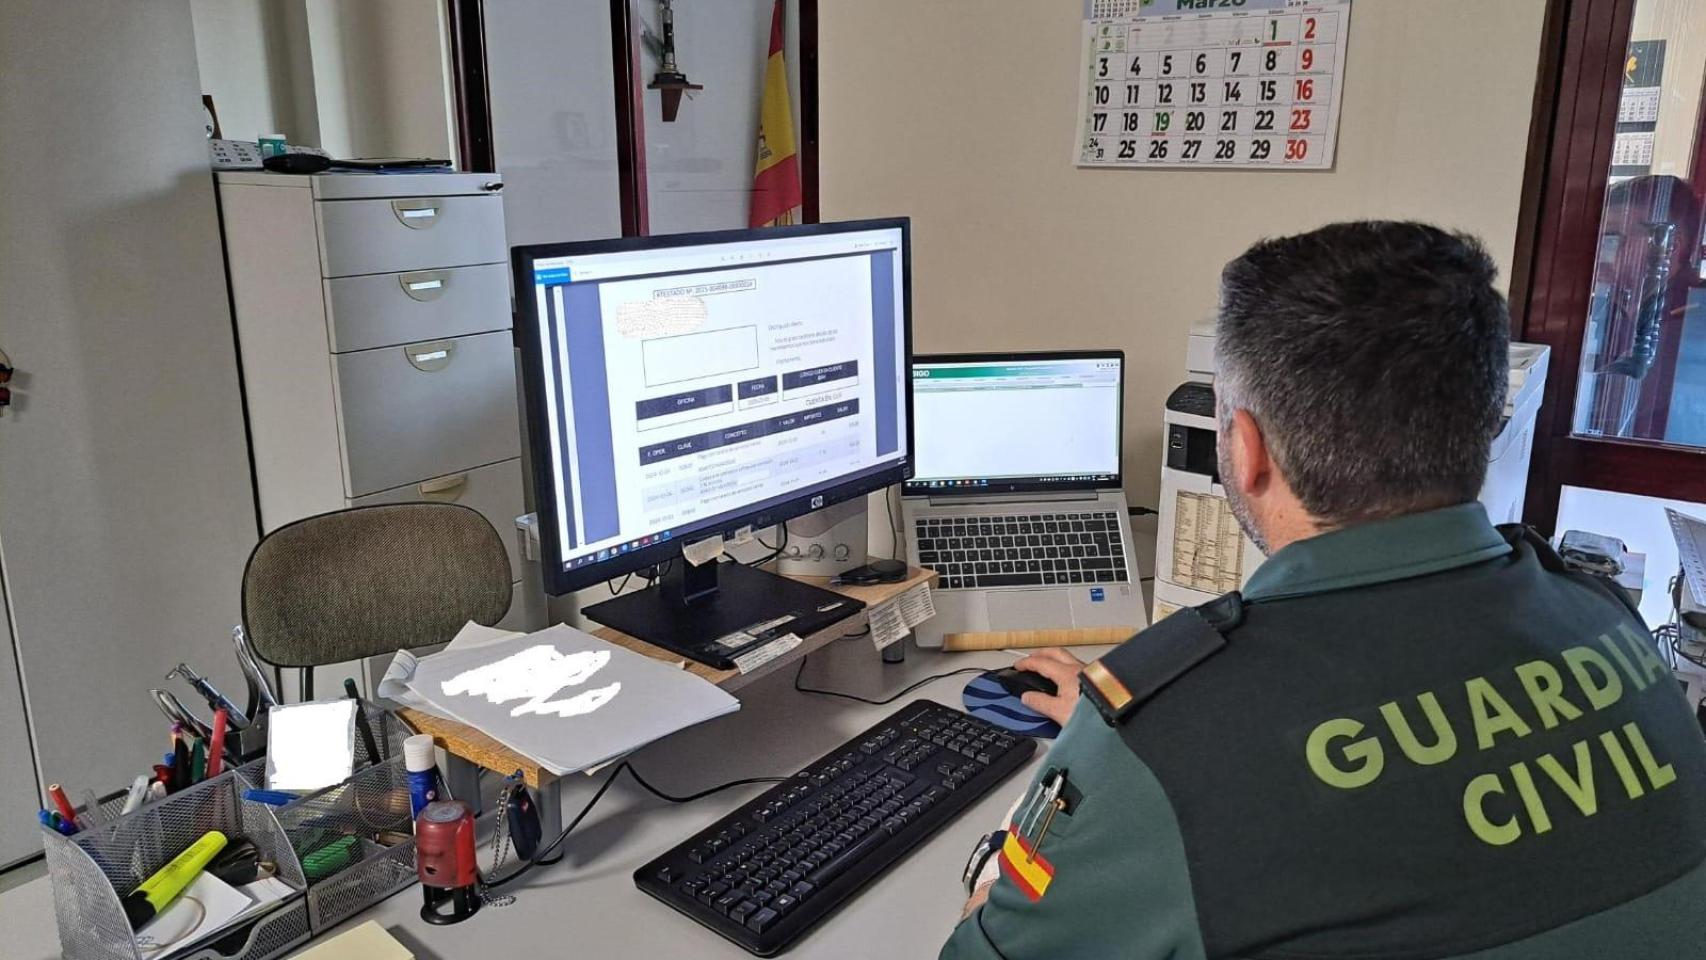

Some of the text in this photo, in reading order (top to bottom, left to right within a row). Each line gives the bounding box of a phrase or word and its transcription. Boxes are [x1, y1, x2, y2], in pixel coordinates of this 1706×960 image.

[1270, 20, 1278, 41] 1
[1304, 17, 1316, 39] 2
[1098, 49, 1313, 77] 3 4 5 6 7 8 9
[1094, 79, 1314, 105] 10 11 12 13 14 15 16
[1093, 109, 1312, 132] 17 18 19 20 21 22 23
[1089, 138, 1308, 159] 24 25 26 27 28 29 30
[1096, 148, 1104, 158] 31
[1306, 623, 1668, 790] GUARDIA
[1463, 721, 1677, 846] CIVIL
